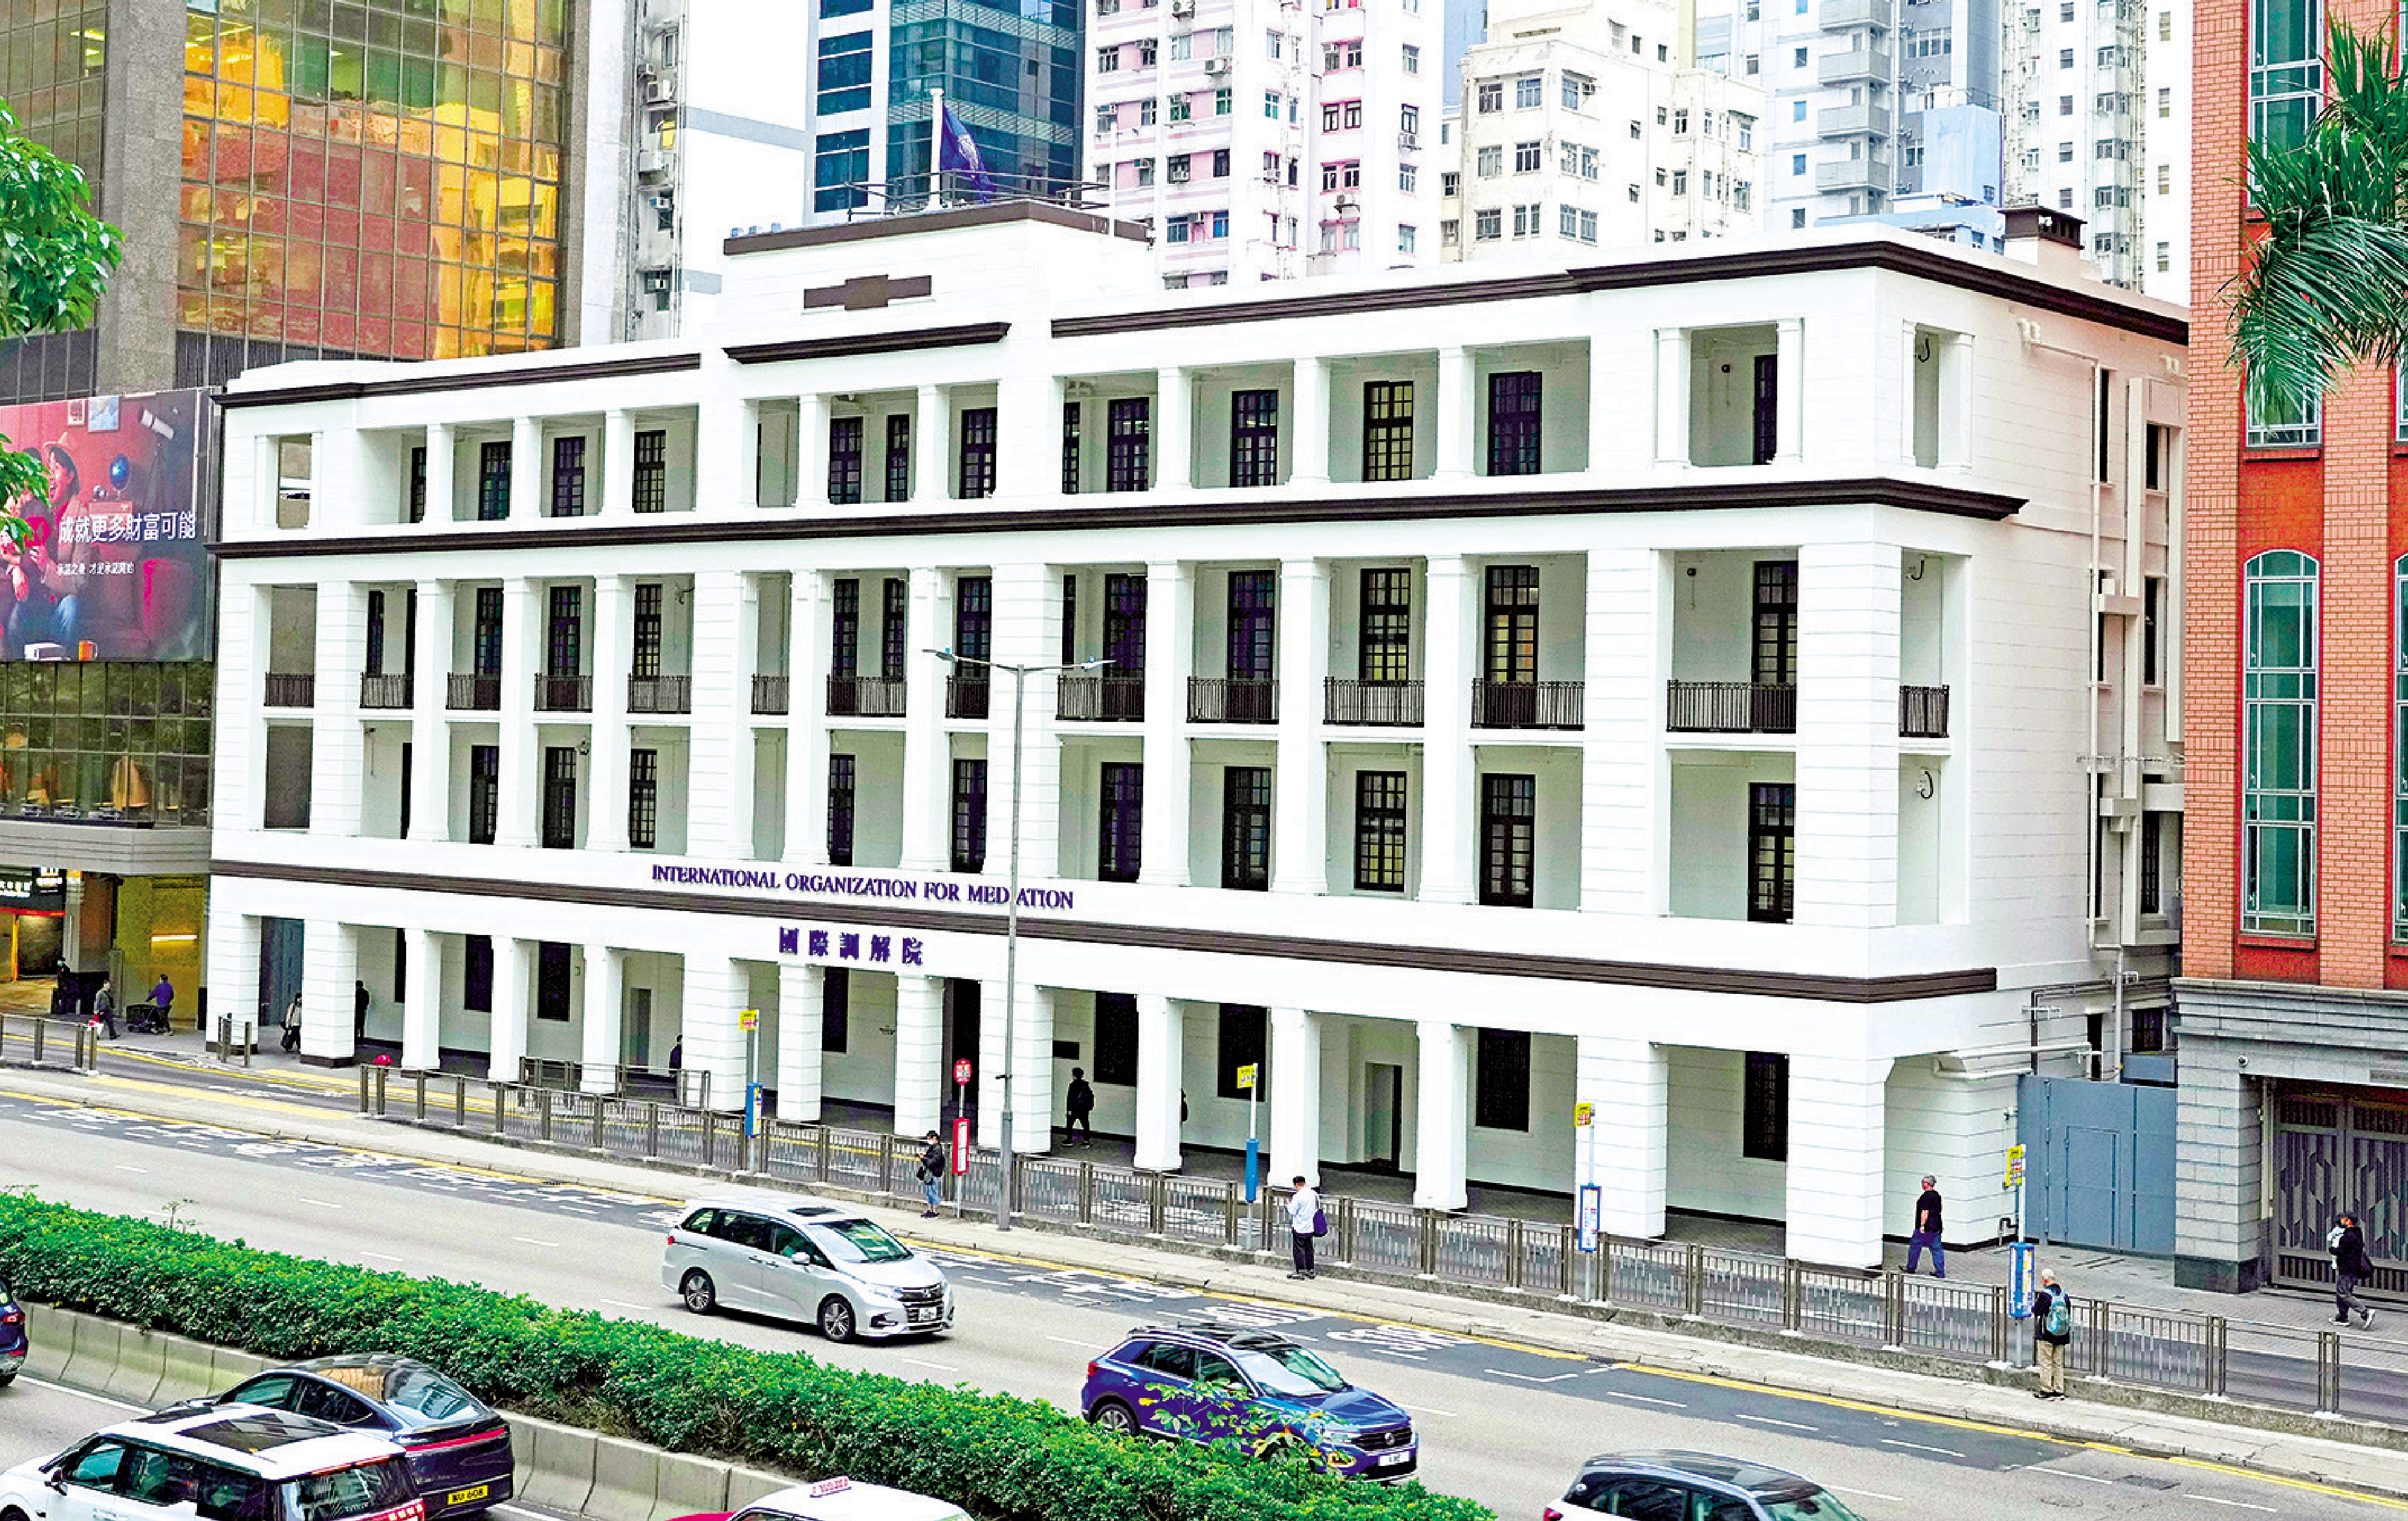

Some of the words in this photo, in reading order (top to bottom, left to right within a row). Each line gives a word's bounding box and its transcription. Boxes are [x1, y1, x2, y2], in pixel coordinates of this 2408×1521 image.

[58, 511, 196, 543] 成就更多財富可能
[652, 864, 780, 889] INTERNATIONAL
[785, 872, 917, 898] ORGANIZATION
[924, 881, 961, 902] FOR
[967, 883, 1073, 909] MEDATION
[778, 926, 923, 965] 國際調解院
